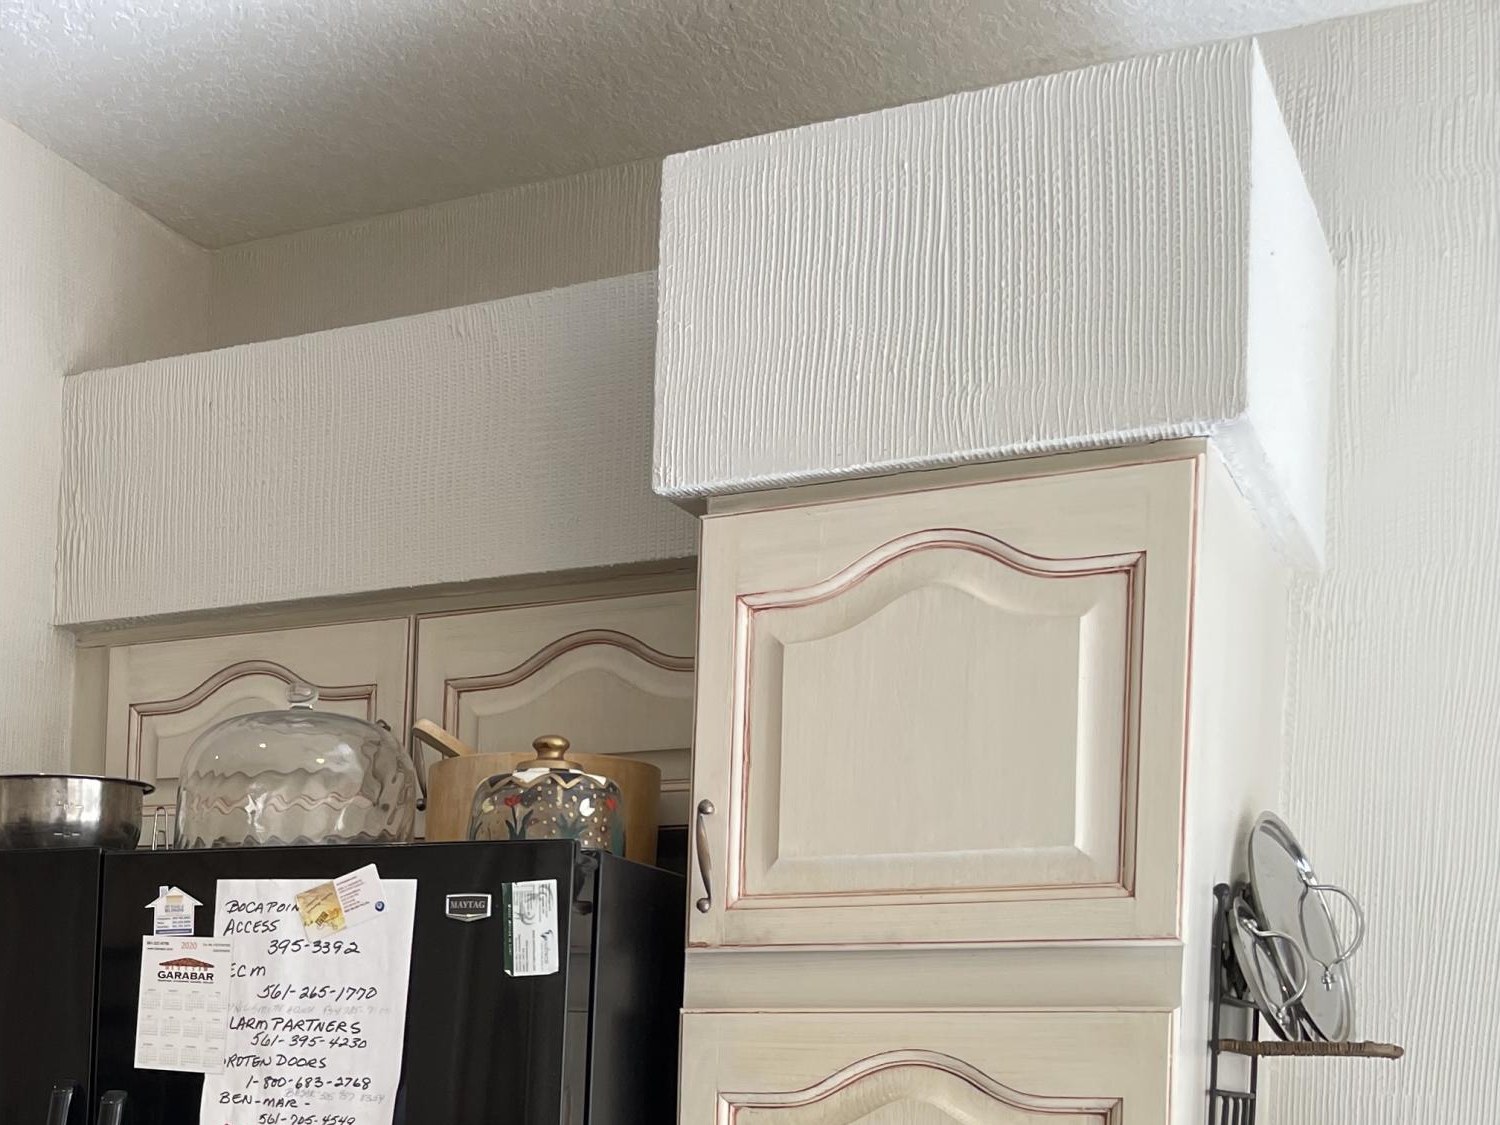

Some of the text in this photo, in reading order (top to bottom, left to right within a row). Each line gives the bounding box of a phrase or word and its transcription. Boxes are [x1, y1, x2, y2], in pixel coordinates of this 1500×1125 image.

[225, 899, 264, 914] BOCA
[450, 900, 486, 909] MAYTAG
[223, 918, 280, 936] ACCESS
[180, 941, 197, 950] 2020
[267, 938, 361, 955] 395-3392
[157, 970, 214, 981] GARABAR
[271, 1016, 362, 1034] PARTNERS
[224, 1053, 327, 1069] ROTEN DOORS
